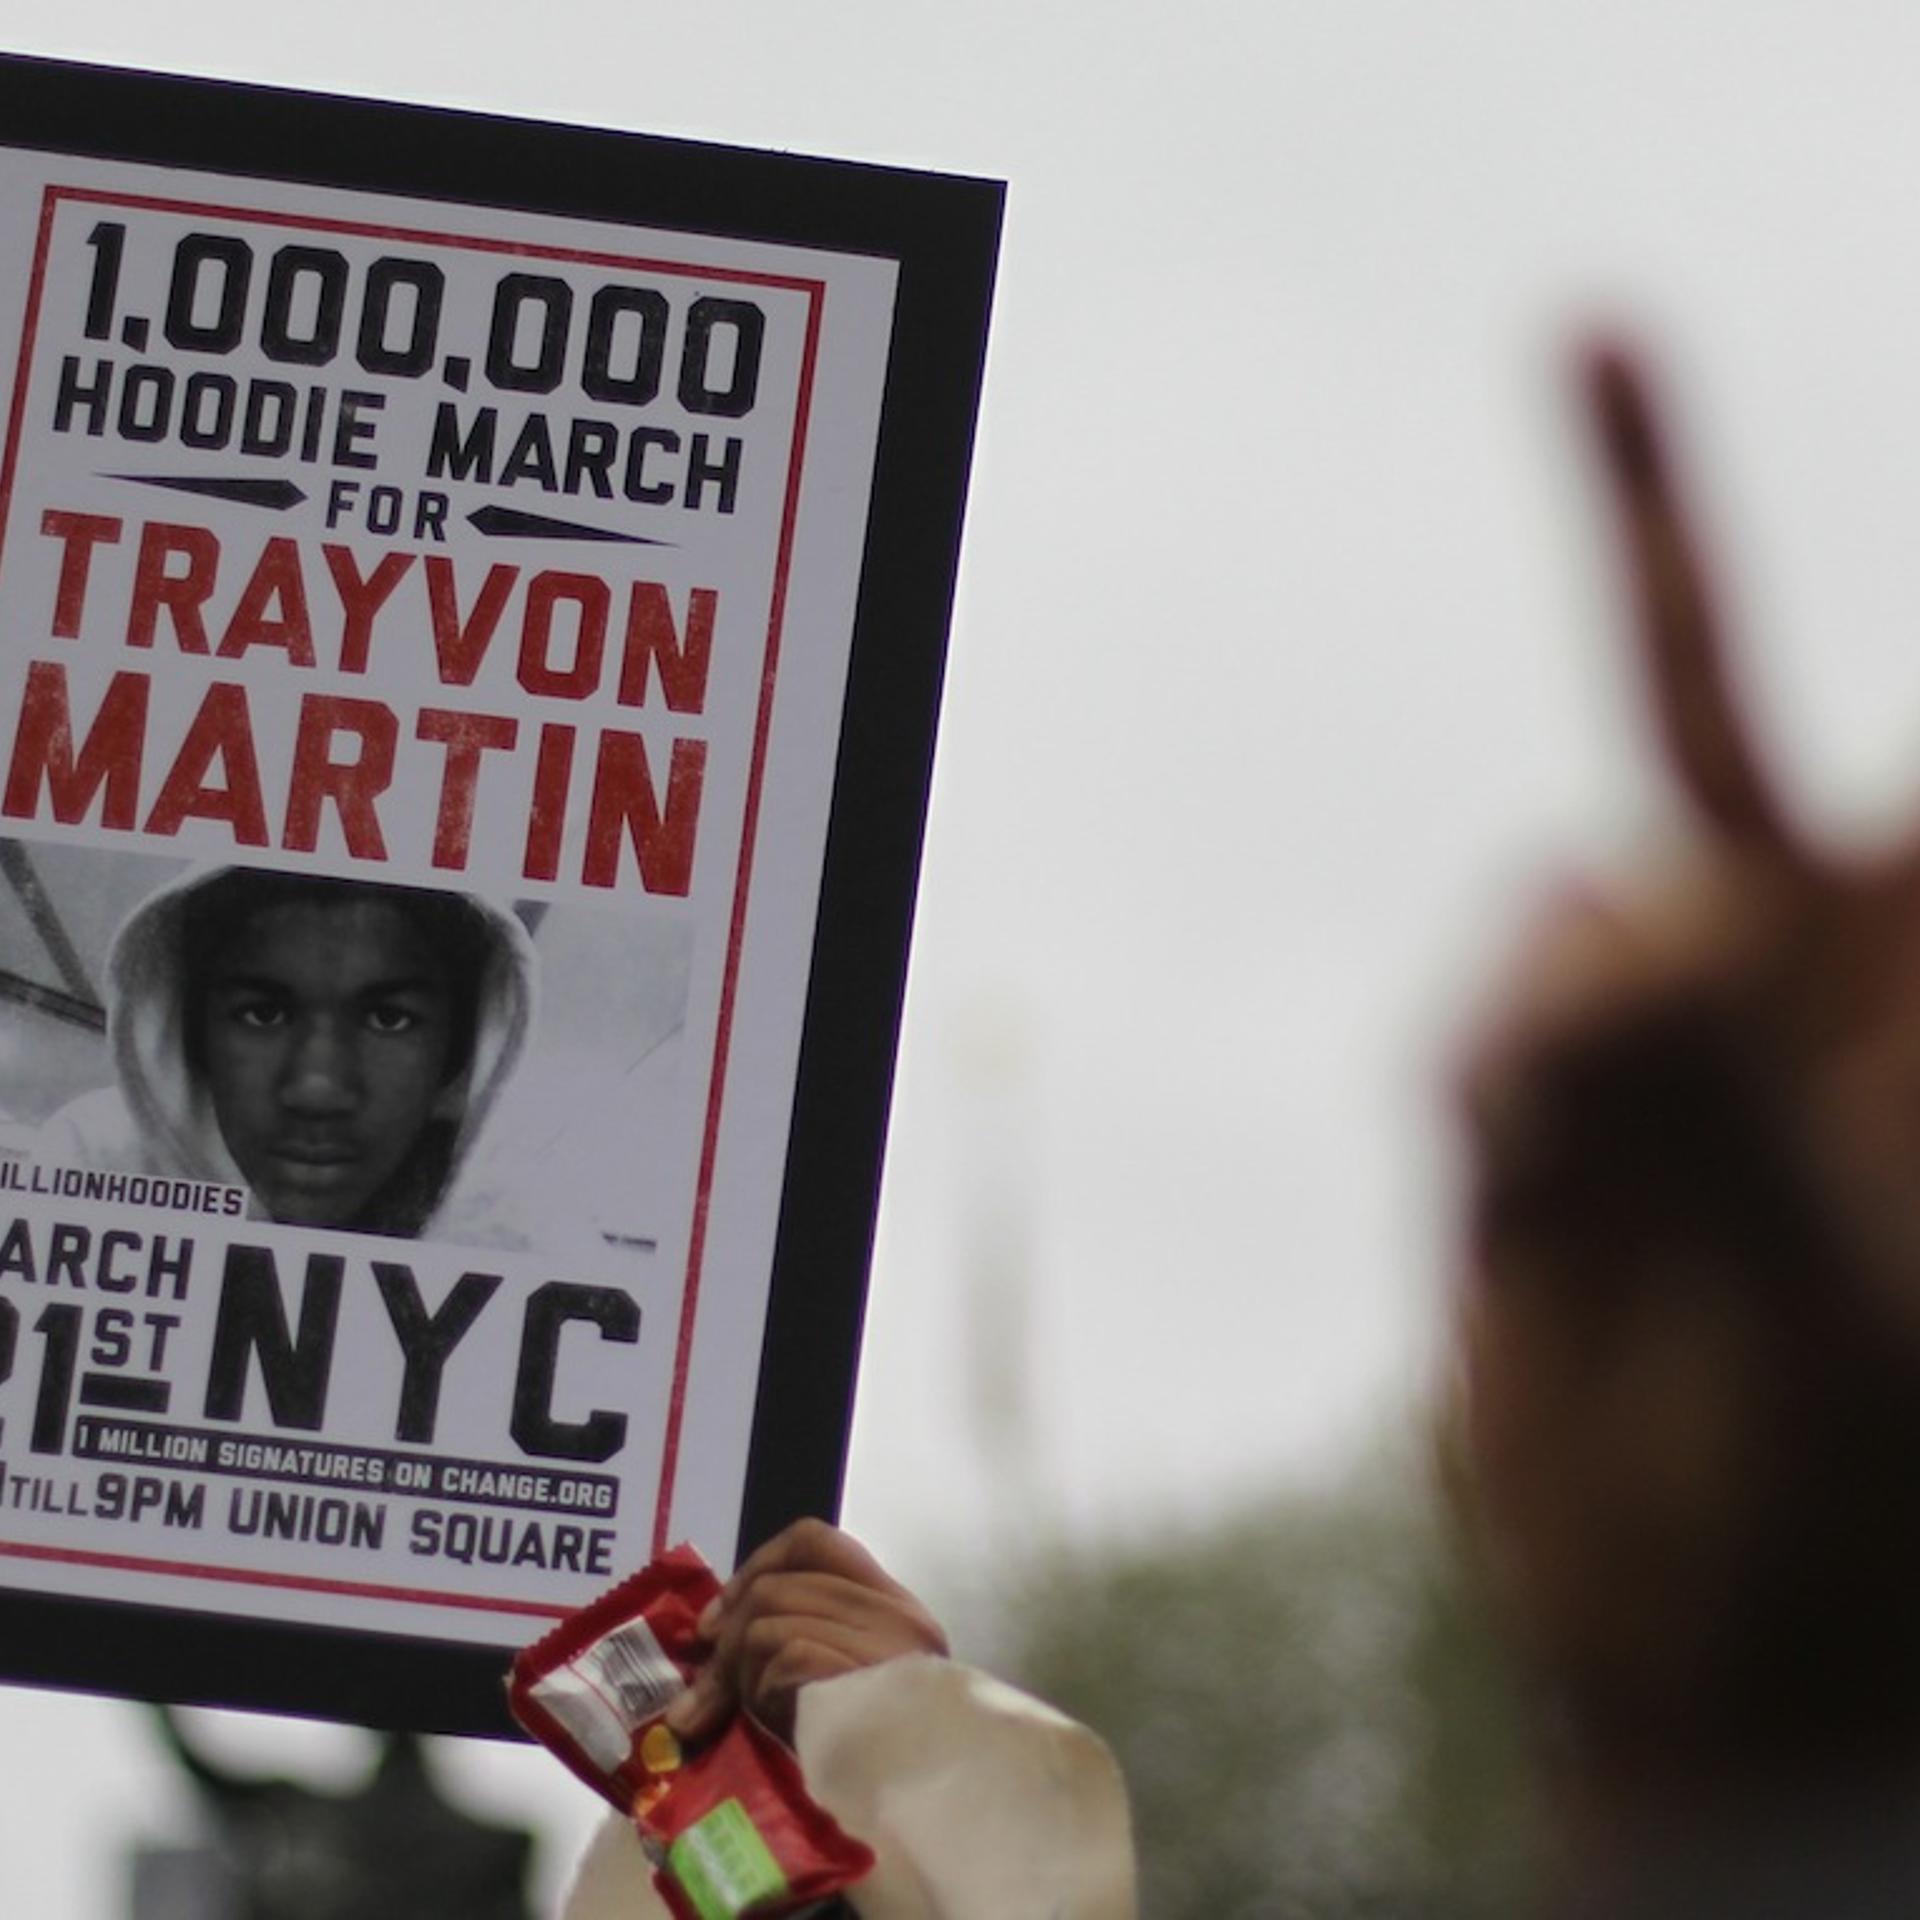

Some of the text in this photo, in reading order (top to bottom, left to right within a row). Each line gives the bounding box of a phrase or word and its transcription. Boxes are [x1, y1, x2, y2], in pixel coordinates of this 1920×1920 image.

[83, 221, 767, 419] 1,000,000
[52, 355, 744, 515] HOODIE MARCH
[324, 478, 450, 543] FOR
[40, 508, 719, 716] TRAYVON
[1, 659, 708, 899] MARTIN
[202, 1242, 642, 1465] NYC
[79, 1424, 612, 1509] 1 MILLION SIGNATURES ON CHANGE.ORG
[94, 1472, 207, 1530] 9PM
[228, 1487, 387, 1551] UNION
[409, 1509, 617, 1577] SQUARE
